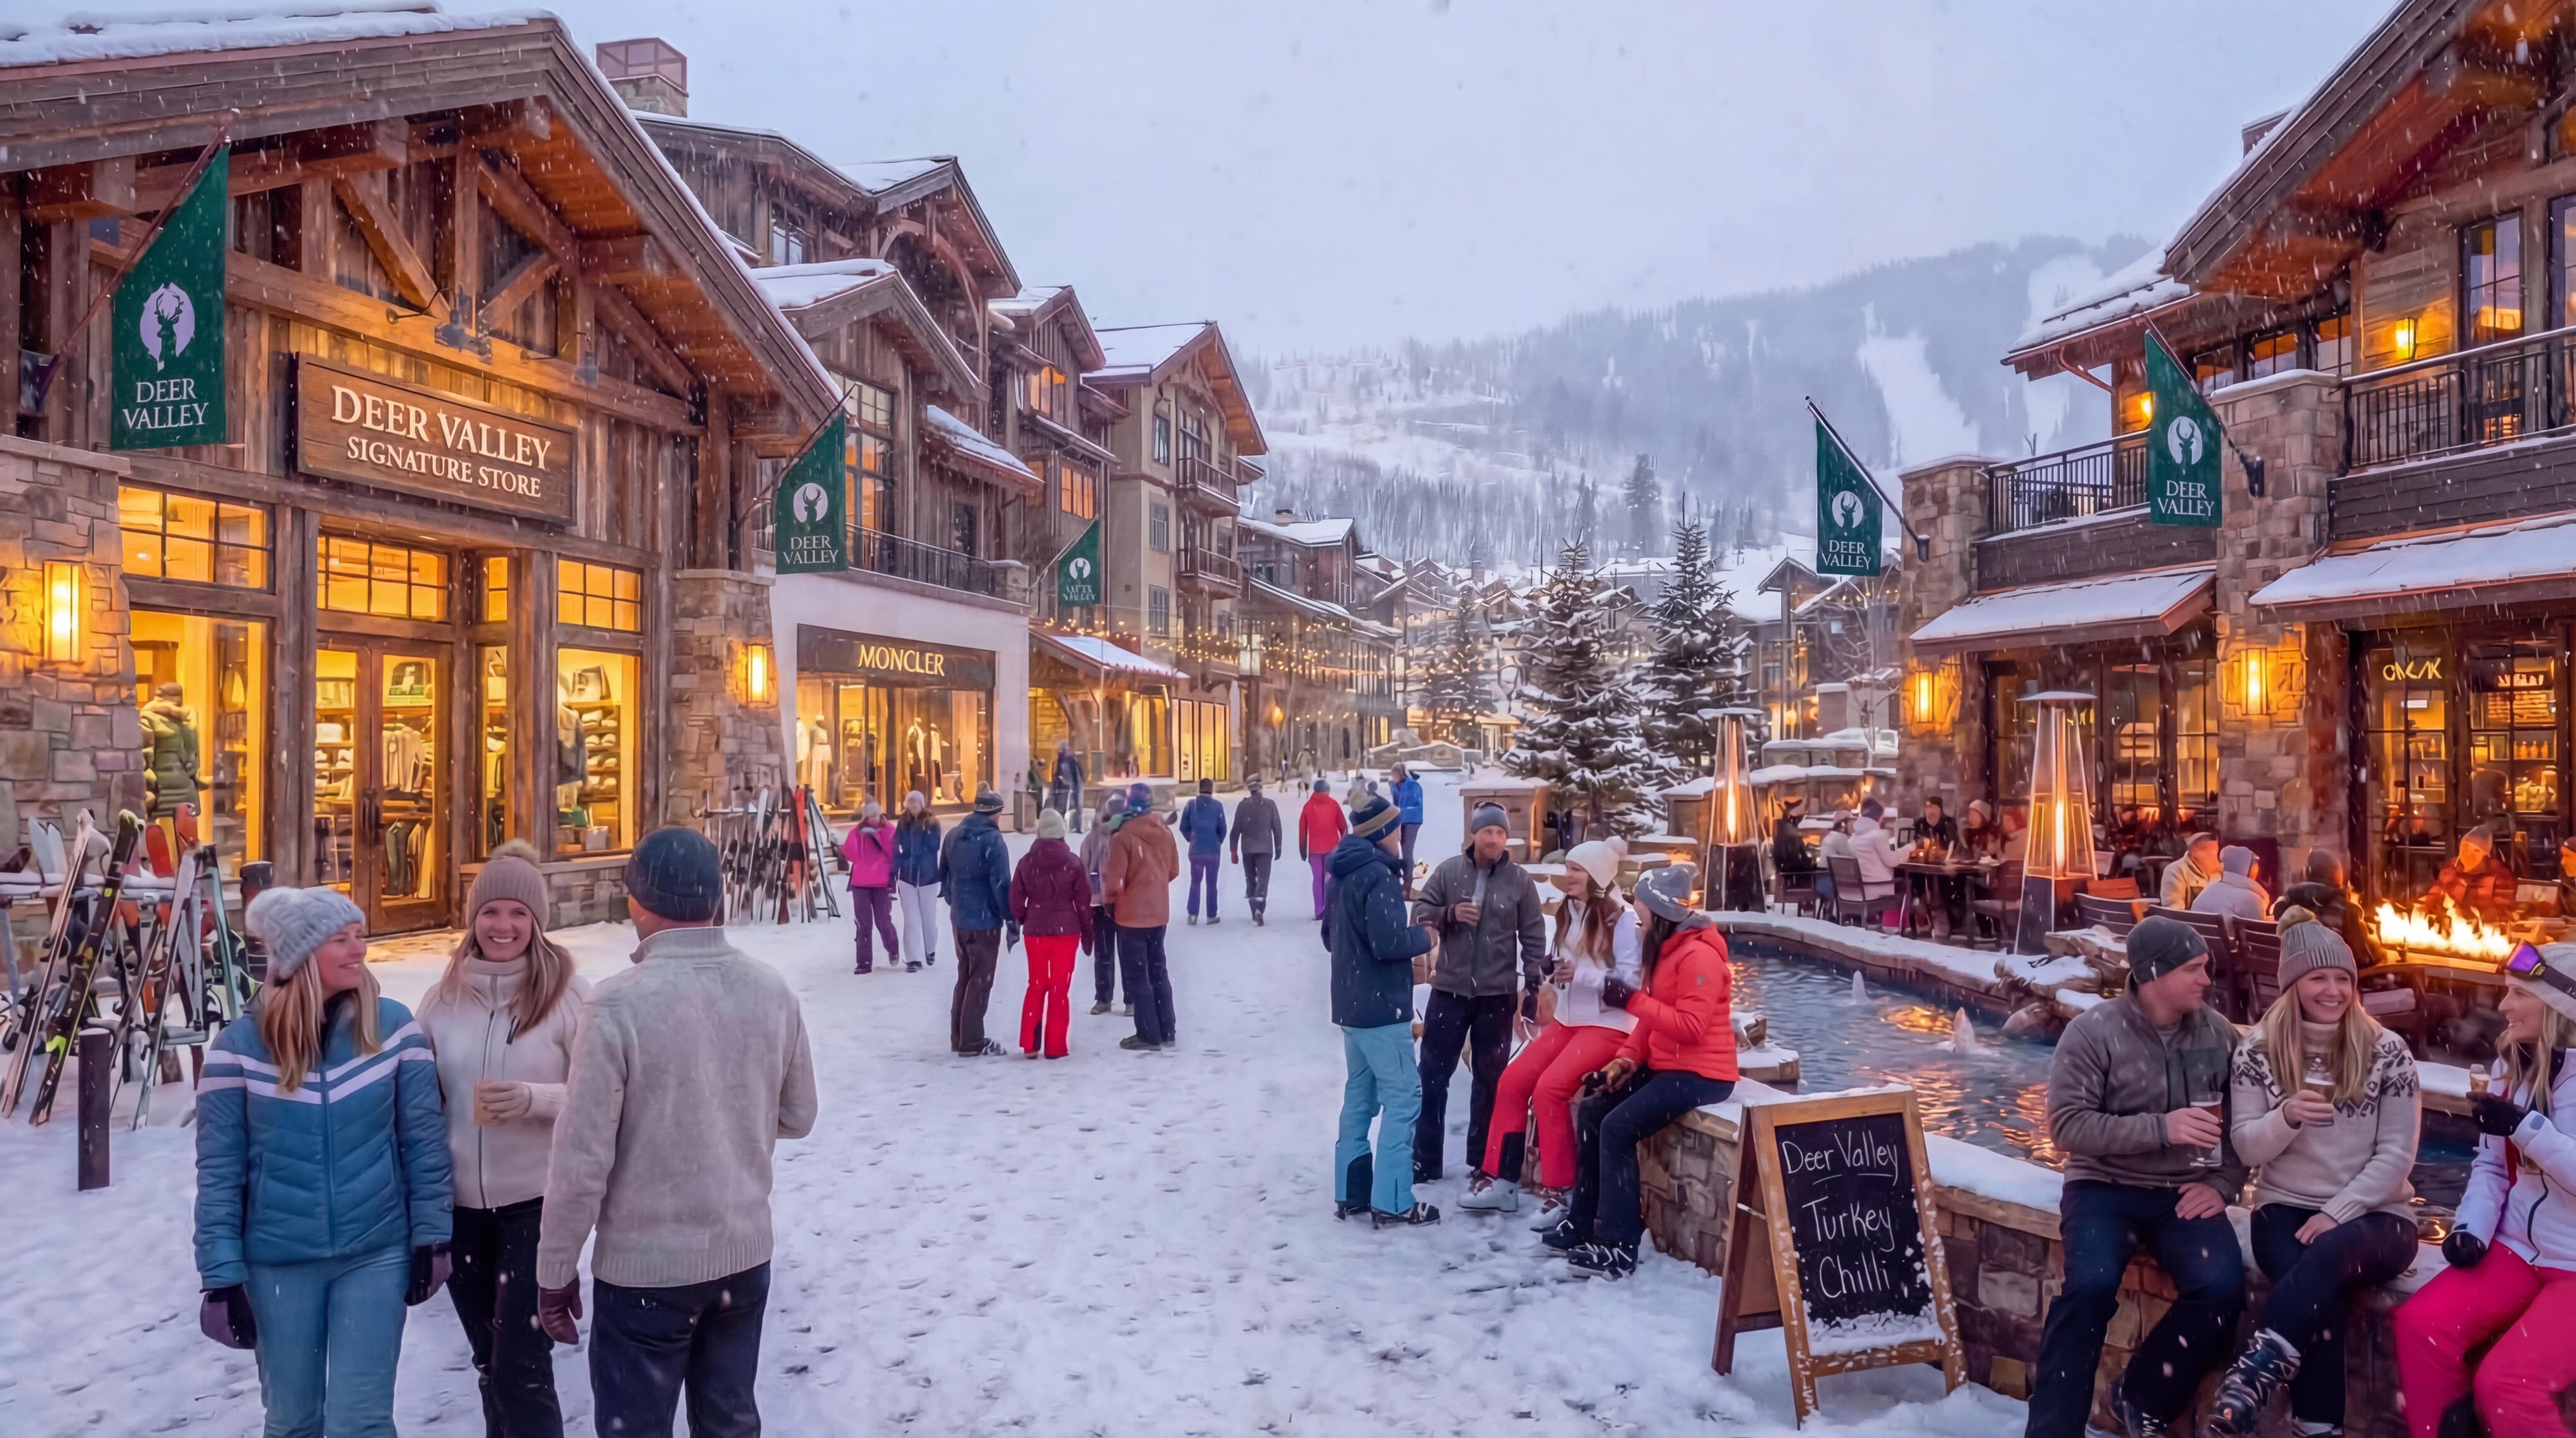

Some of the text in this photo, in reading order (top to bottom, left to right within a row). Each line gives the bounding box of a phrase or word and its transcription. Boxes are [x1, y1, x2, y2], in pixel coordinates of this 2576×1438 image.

[135, 378, 197, 404] DEER
[122, 402, 209, 430] VALLEY
[331, 385, 551, 470] DEER VALLEY
[347, 436, 542, 498] SIGNATURE STORE
[2166, 480, 2207, 499] DEER
[2157, 497, 2215, 516] VALLEY
[790, 536, 832, 550] DEER
[1829, 540, 1866, 555] DEER
[783, 549, 839, 565] VALLEY
[1822, 552, 1872, 570] VALLEY
[857, 644, 945, 677] MONCLER
[1781, 1130, 1898, 1186] Deer Valley
[1802, 1196, 1895, 1252] Turkey
[1819, 1249, 1891, 1299] Chilli
